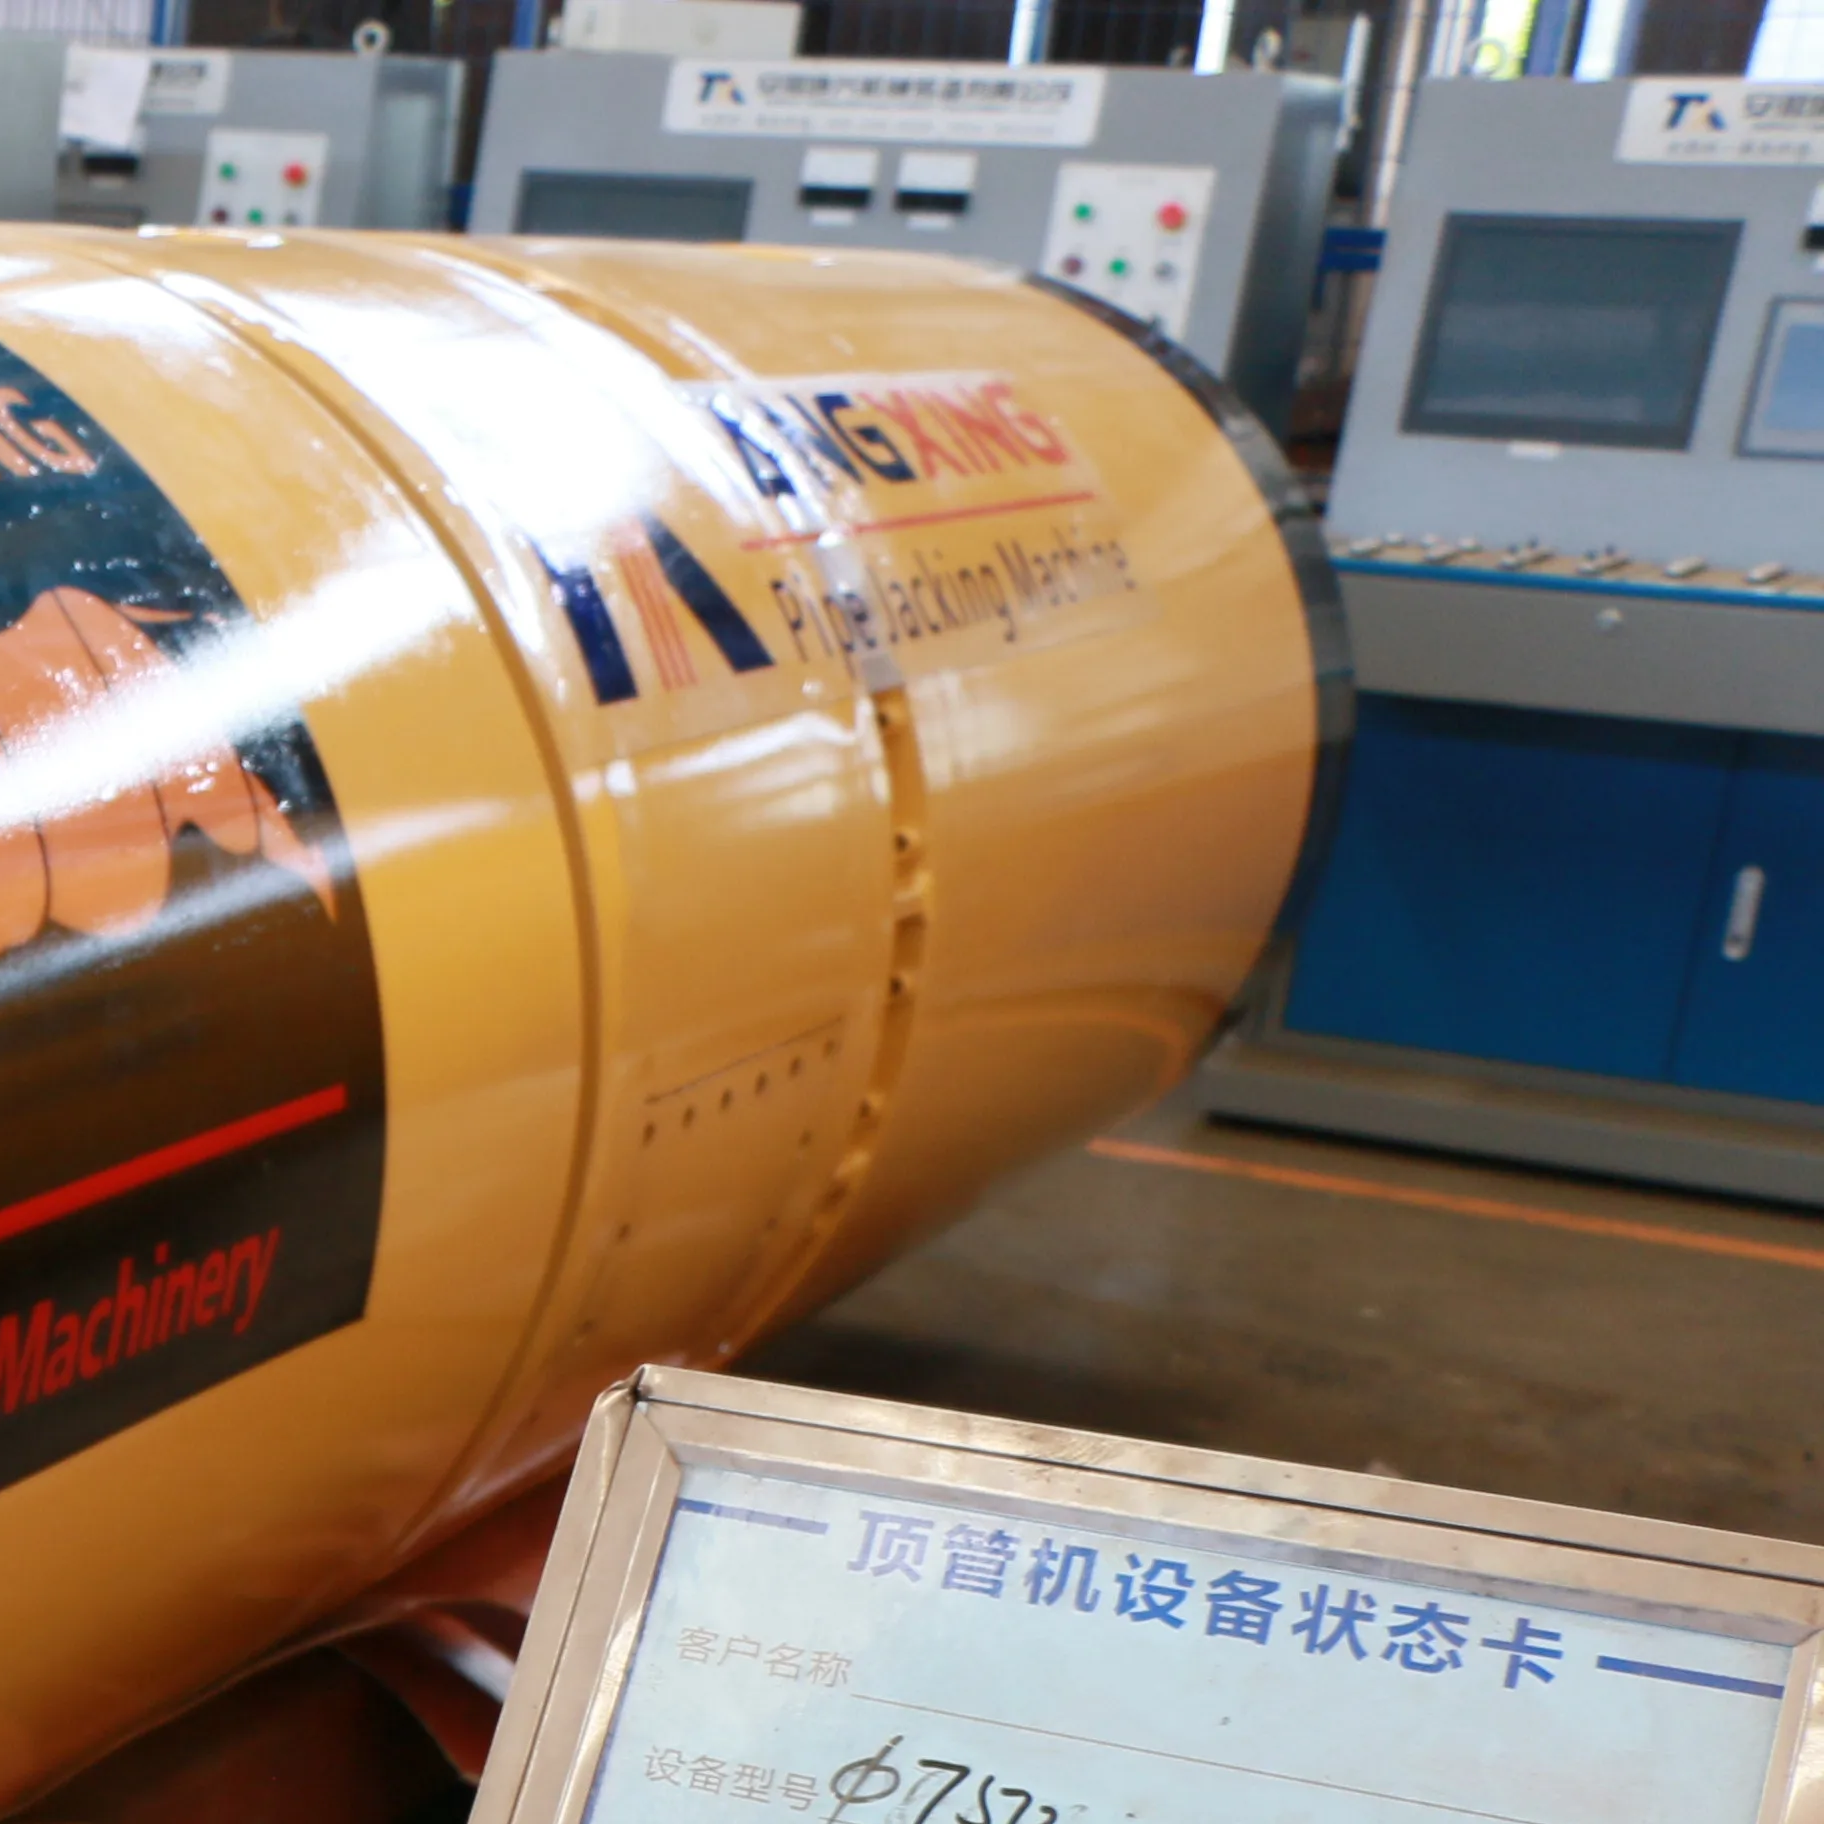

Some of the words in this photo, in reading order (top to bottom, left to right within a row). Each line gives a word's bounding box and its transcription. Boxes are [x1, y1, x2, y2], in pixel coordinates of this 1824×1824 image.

[865, 547, 1017, 643] Jacking
[847, 1508, 1564, 1690] 顶管机设备状态卡
[675, 1626, 852, 1689] 客户名称
[642, 1746, 820, 1812] 设备型号
